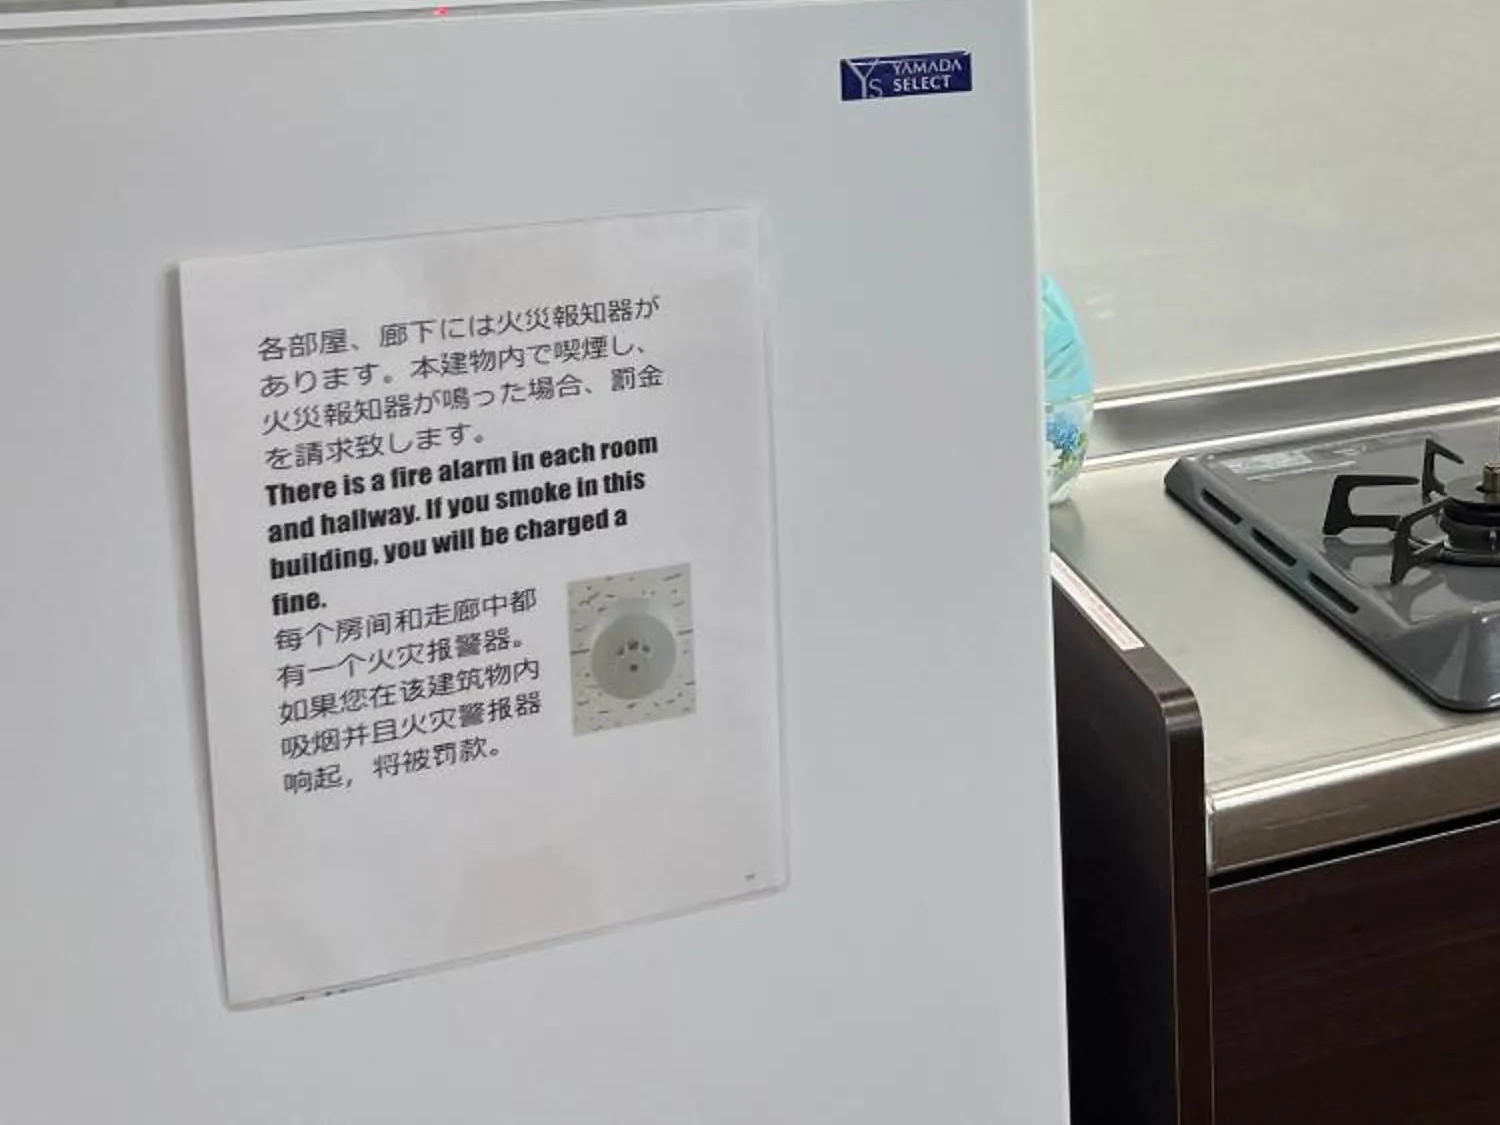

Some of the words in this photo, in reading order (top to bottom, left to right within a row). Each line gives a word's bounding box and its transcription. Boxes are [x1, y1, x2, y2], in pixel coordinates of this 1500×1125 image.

[892, 58, 963, 76] YAMADA
[893, 74, 952, 92] SELECT
[257, 295, 660, 362] 各部屋、廊下には火災報知器が
[262, 364, 664, 436] 火災報知器が鳴った場合、罰金
[265, 422, 484, 471] を請求致します。
[265, 479, 337, 507] There
[343, 474, 365, 496] is
[370, 473, 385, 492] a
[390, 466, 433, 489] fire
[438, 456, 507, 483] alarm
[512, 450, 535, 472] in
[540, 442, 596, 468] each
[600, 436, 659, 460] room
[268, 515, 315, 543] and
[320, 504, 421, 536] hallway.
[425, 495, 443, 520] If
[447, 493, 490, 519] you
[495, 481, 572, 510] smoke
[576, 476, 599, 498] in
[603, 470, 646, 494] this
[269, 546, 379, 580] building,
[383, 538, 427, 564] you
[432, 526, 475, 554] will
[480, 525, 509, 548] be
[514, 508, 609, 543] charged
[613, 508, 628, 527] a
[271, 591, 327, 616] fine.
[278, 658, 540, 725] 如果您在该建筑物内
[281, 690, 542, 760] 吸烟并且火灾警报器
